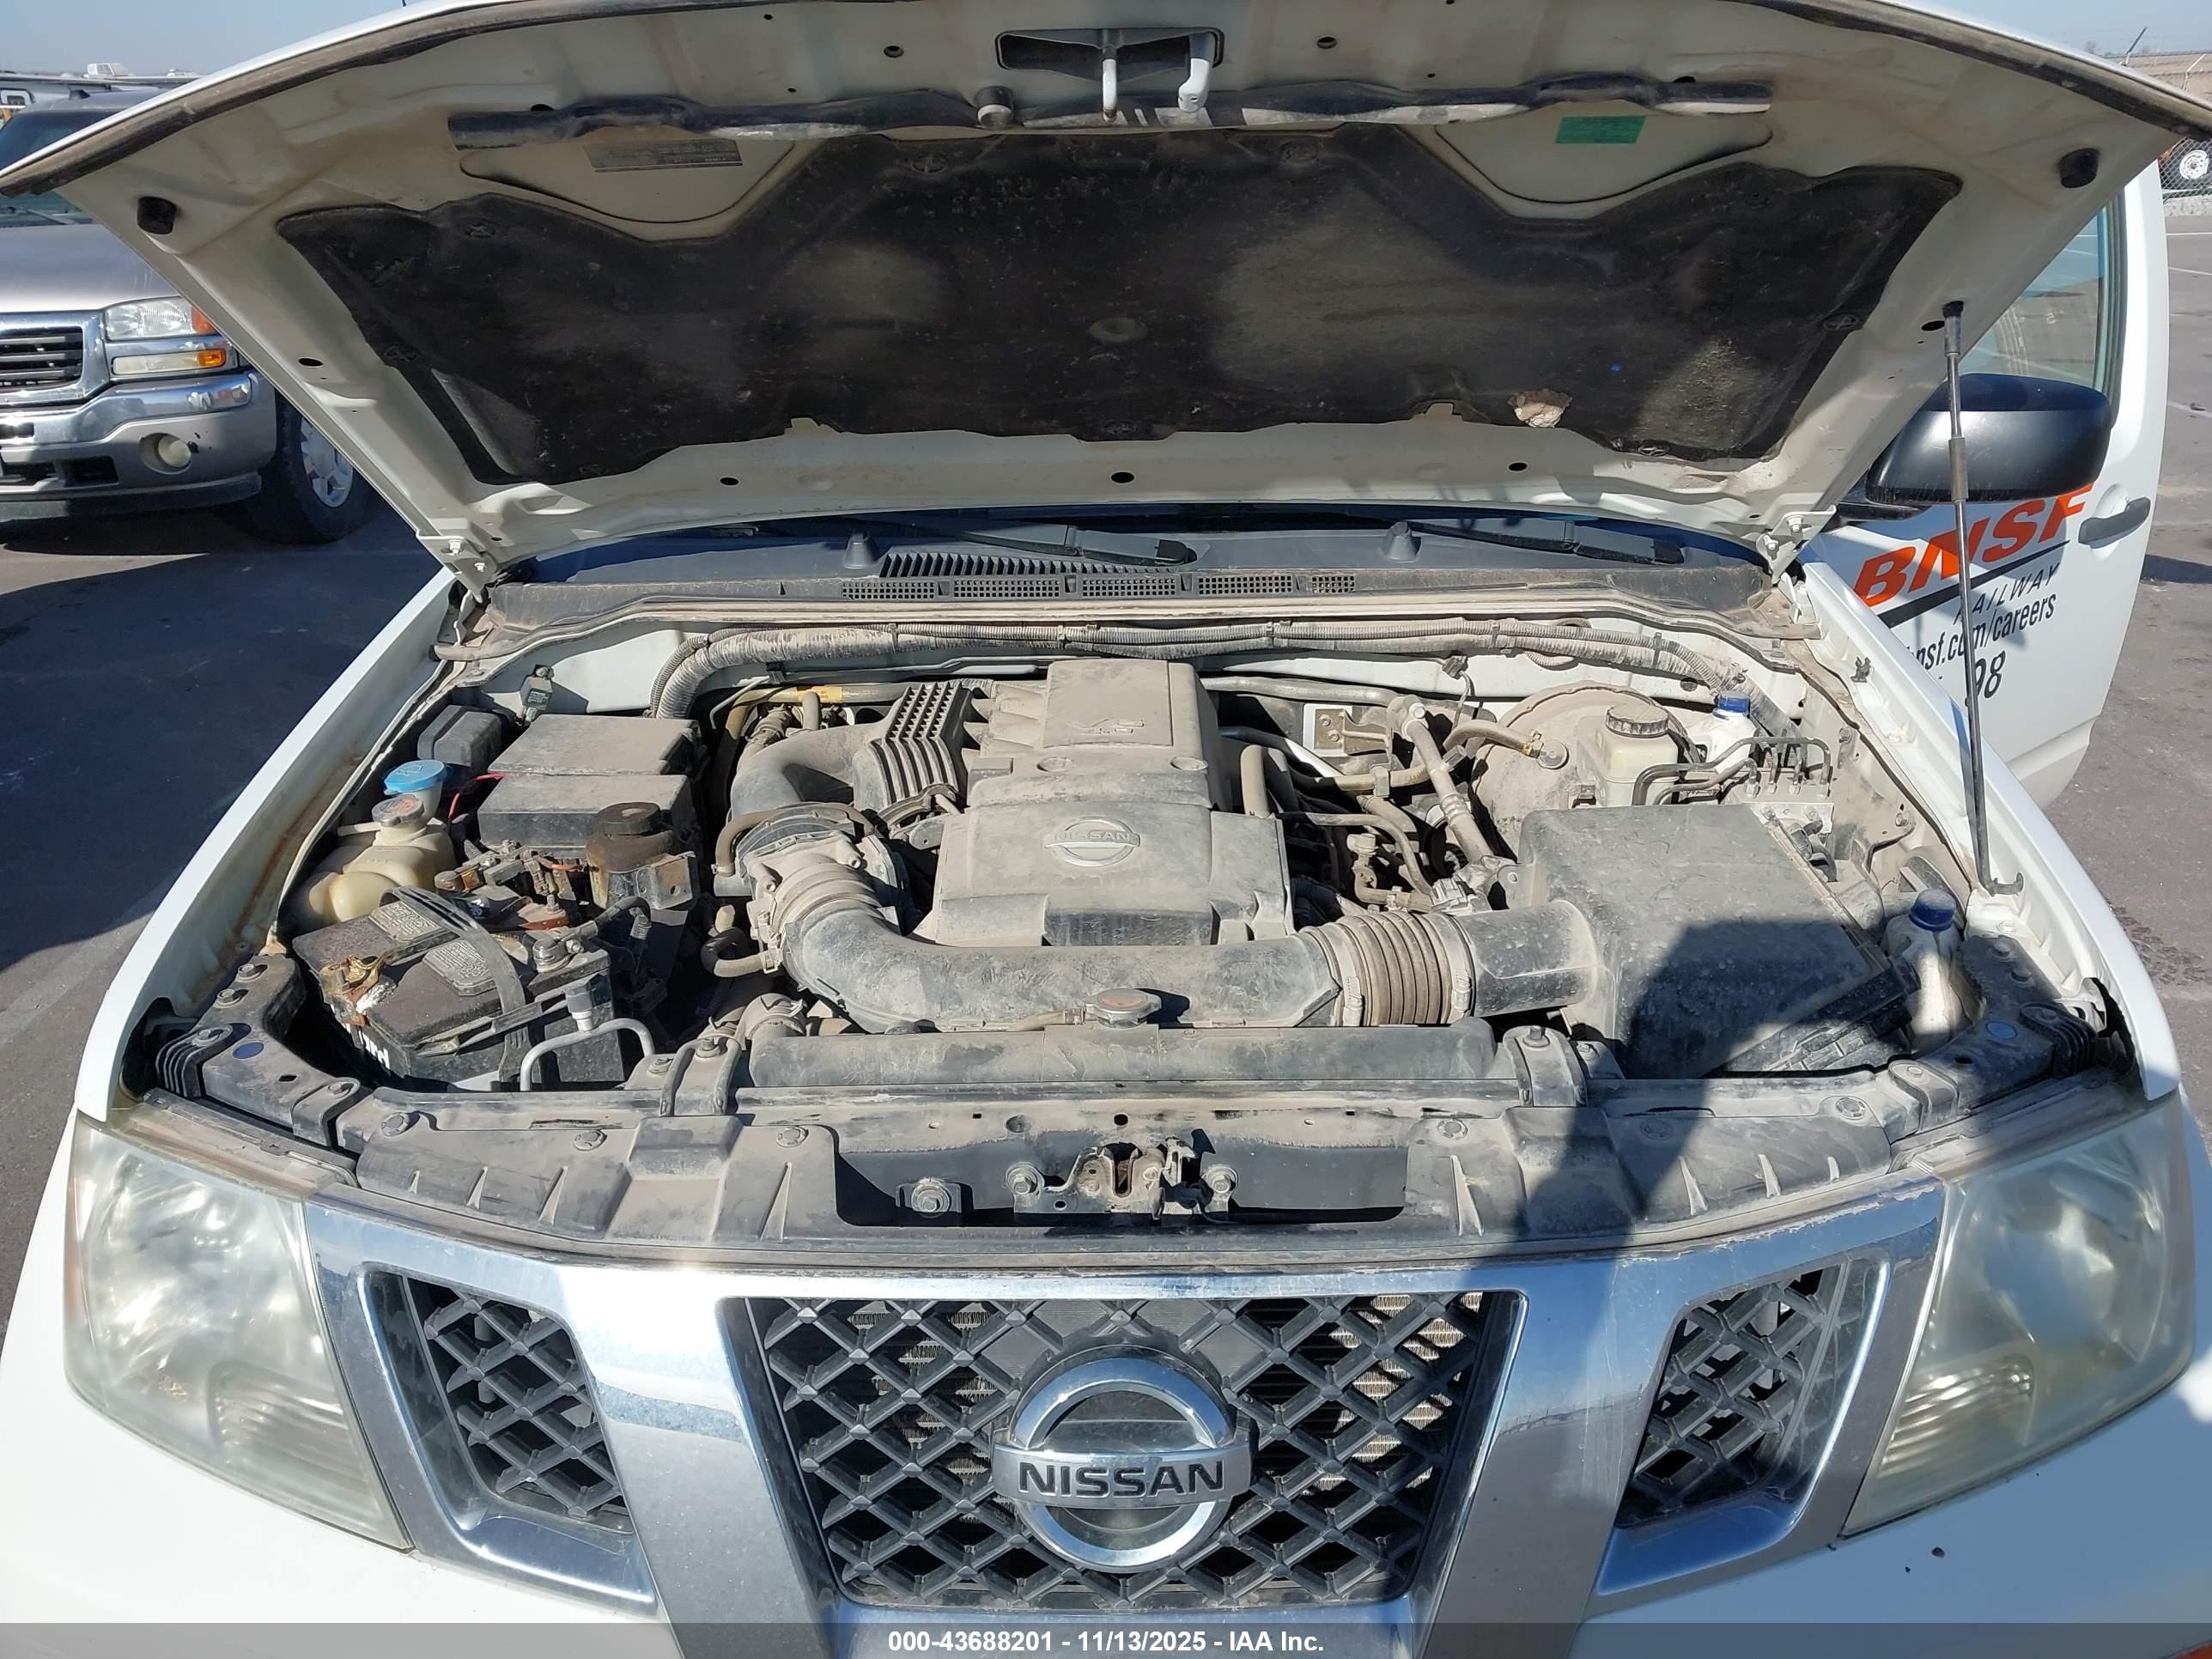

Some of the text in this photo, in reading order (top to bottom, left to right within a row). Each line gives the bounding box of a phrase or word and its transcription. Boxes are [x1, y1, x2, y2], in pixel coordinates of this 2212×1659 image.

[1854, 483, 2094, 607] BNSF
[1907, 593, 2057, 671] nsf.com/careers
[1018, 1462, 1224, 1497] NISSAN
